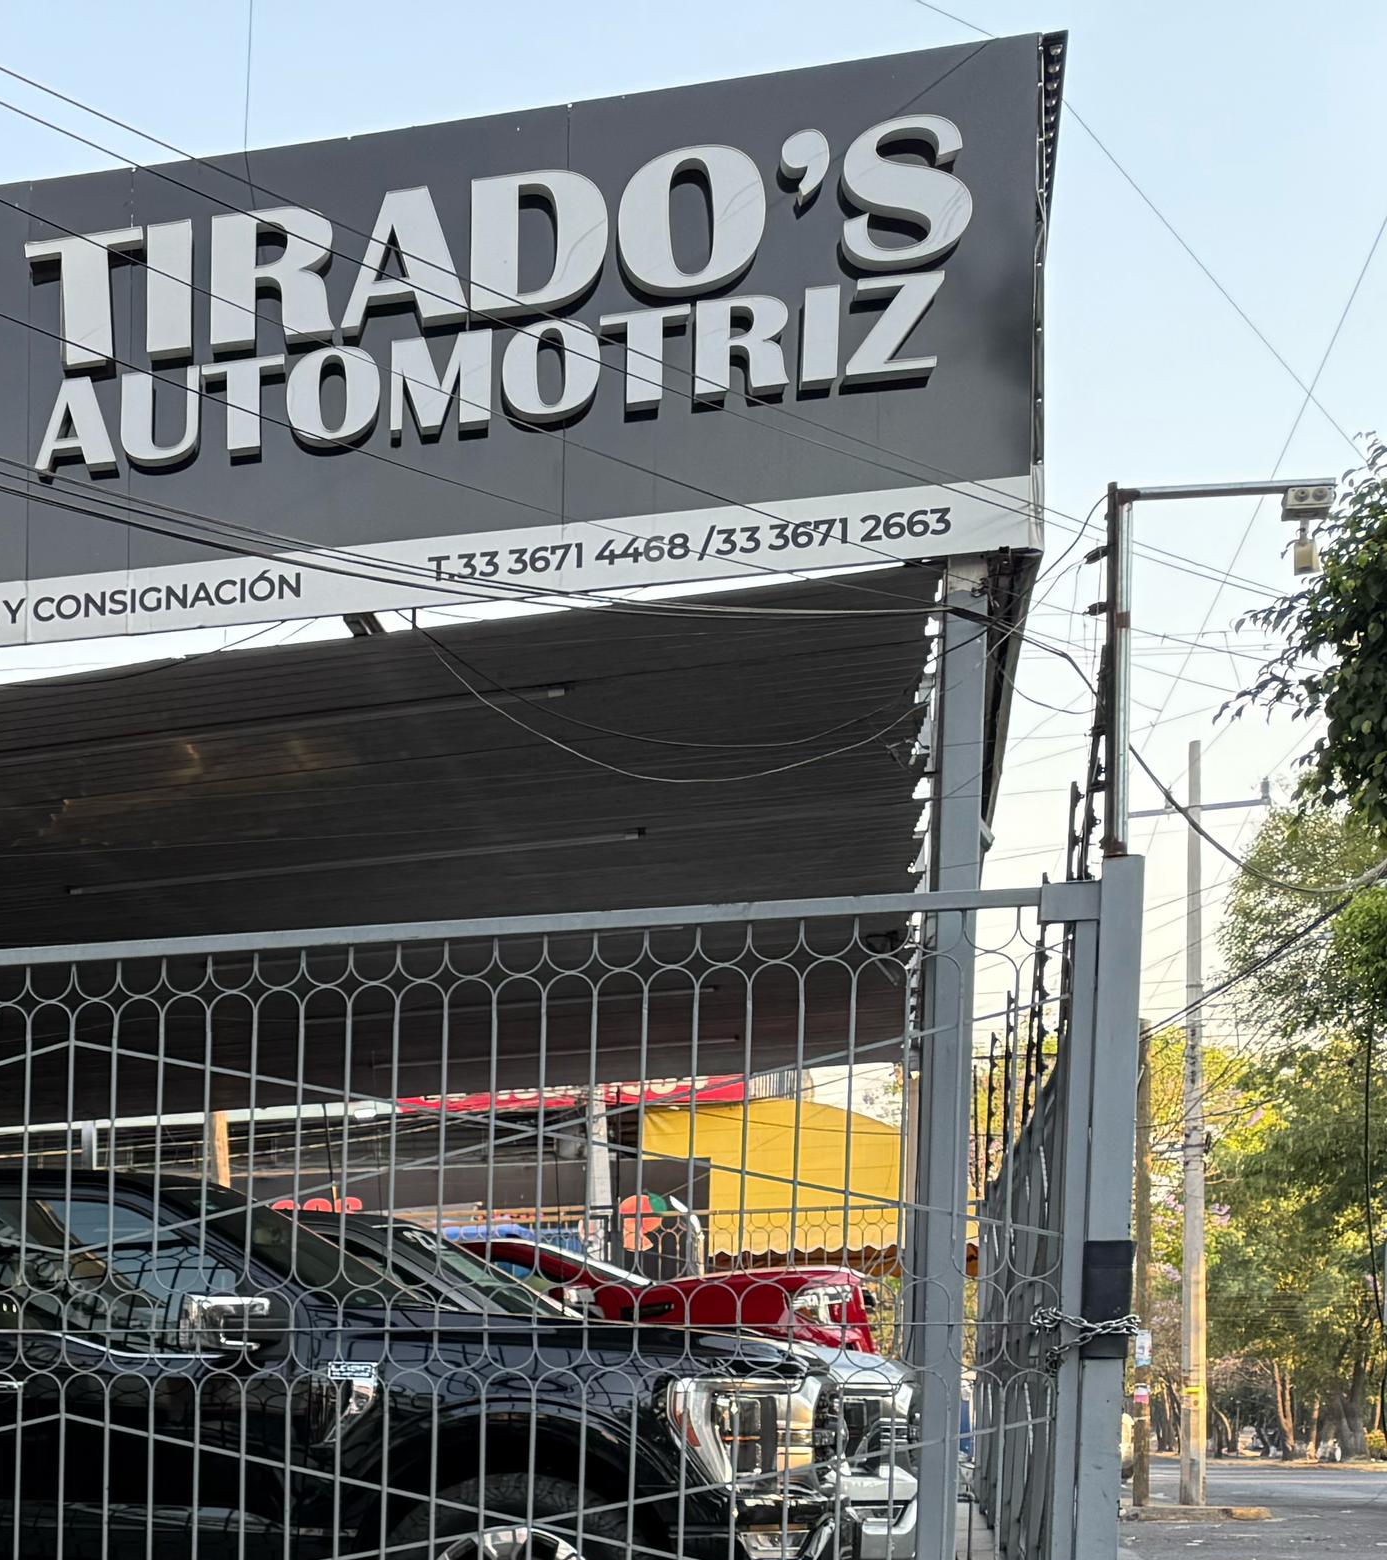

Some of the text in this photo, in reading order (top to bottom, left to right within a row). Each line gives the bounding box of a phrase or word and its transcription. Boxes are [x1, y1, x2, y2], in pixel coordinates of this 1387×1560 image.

[24, 113, 973, 371] TIRADO'S
[35, 269, 945, 478] AUTOMOTRIZ
[1, 598, 27, 625] Y
[31, 570, 303, 623] CONSIGNACIÓN
[507, 542, 584, 576] 3671
[595, 532, 690, 566] 4468
[767, 517, 849, 552] 3671
[860, 507, 952, 543] 2663
